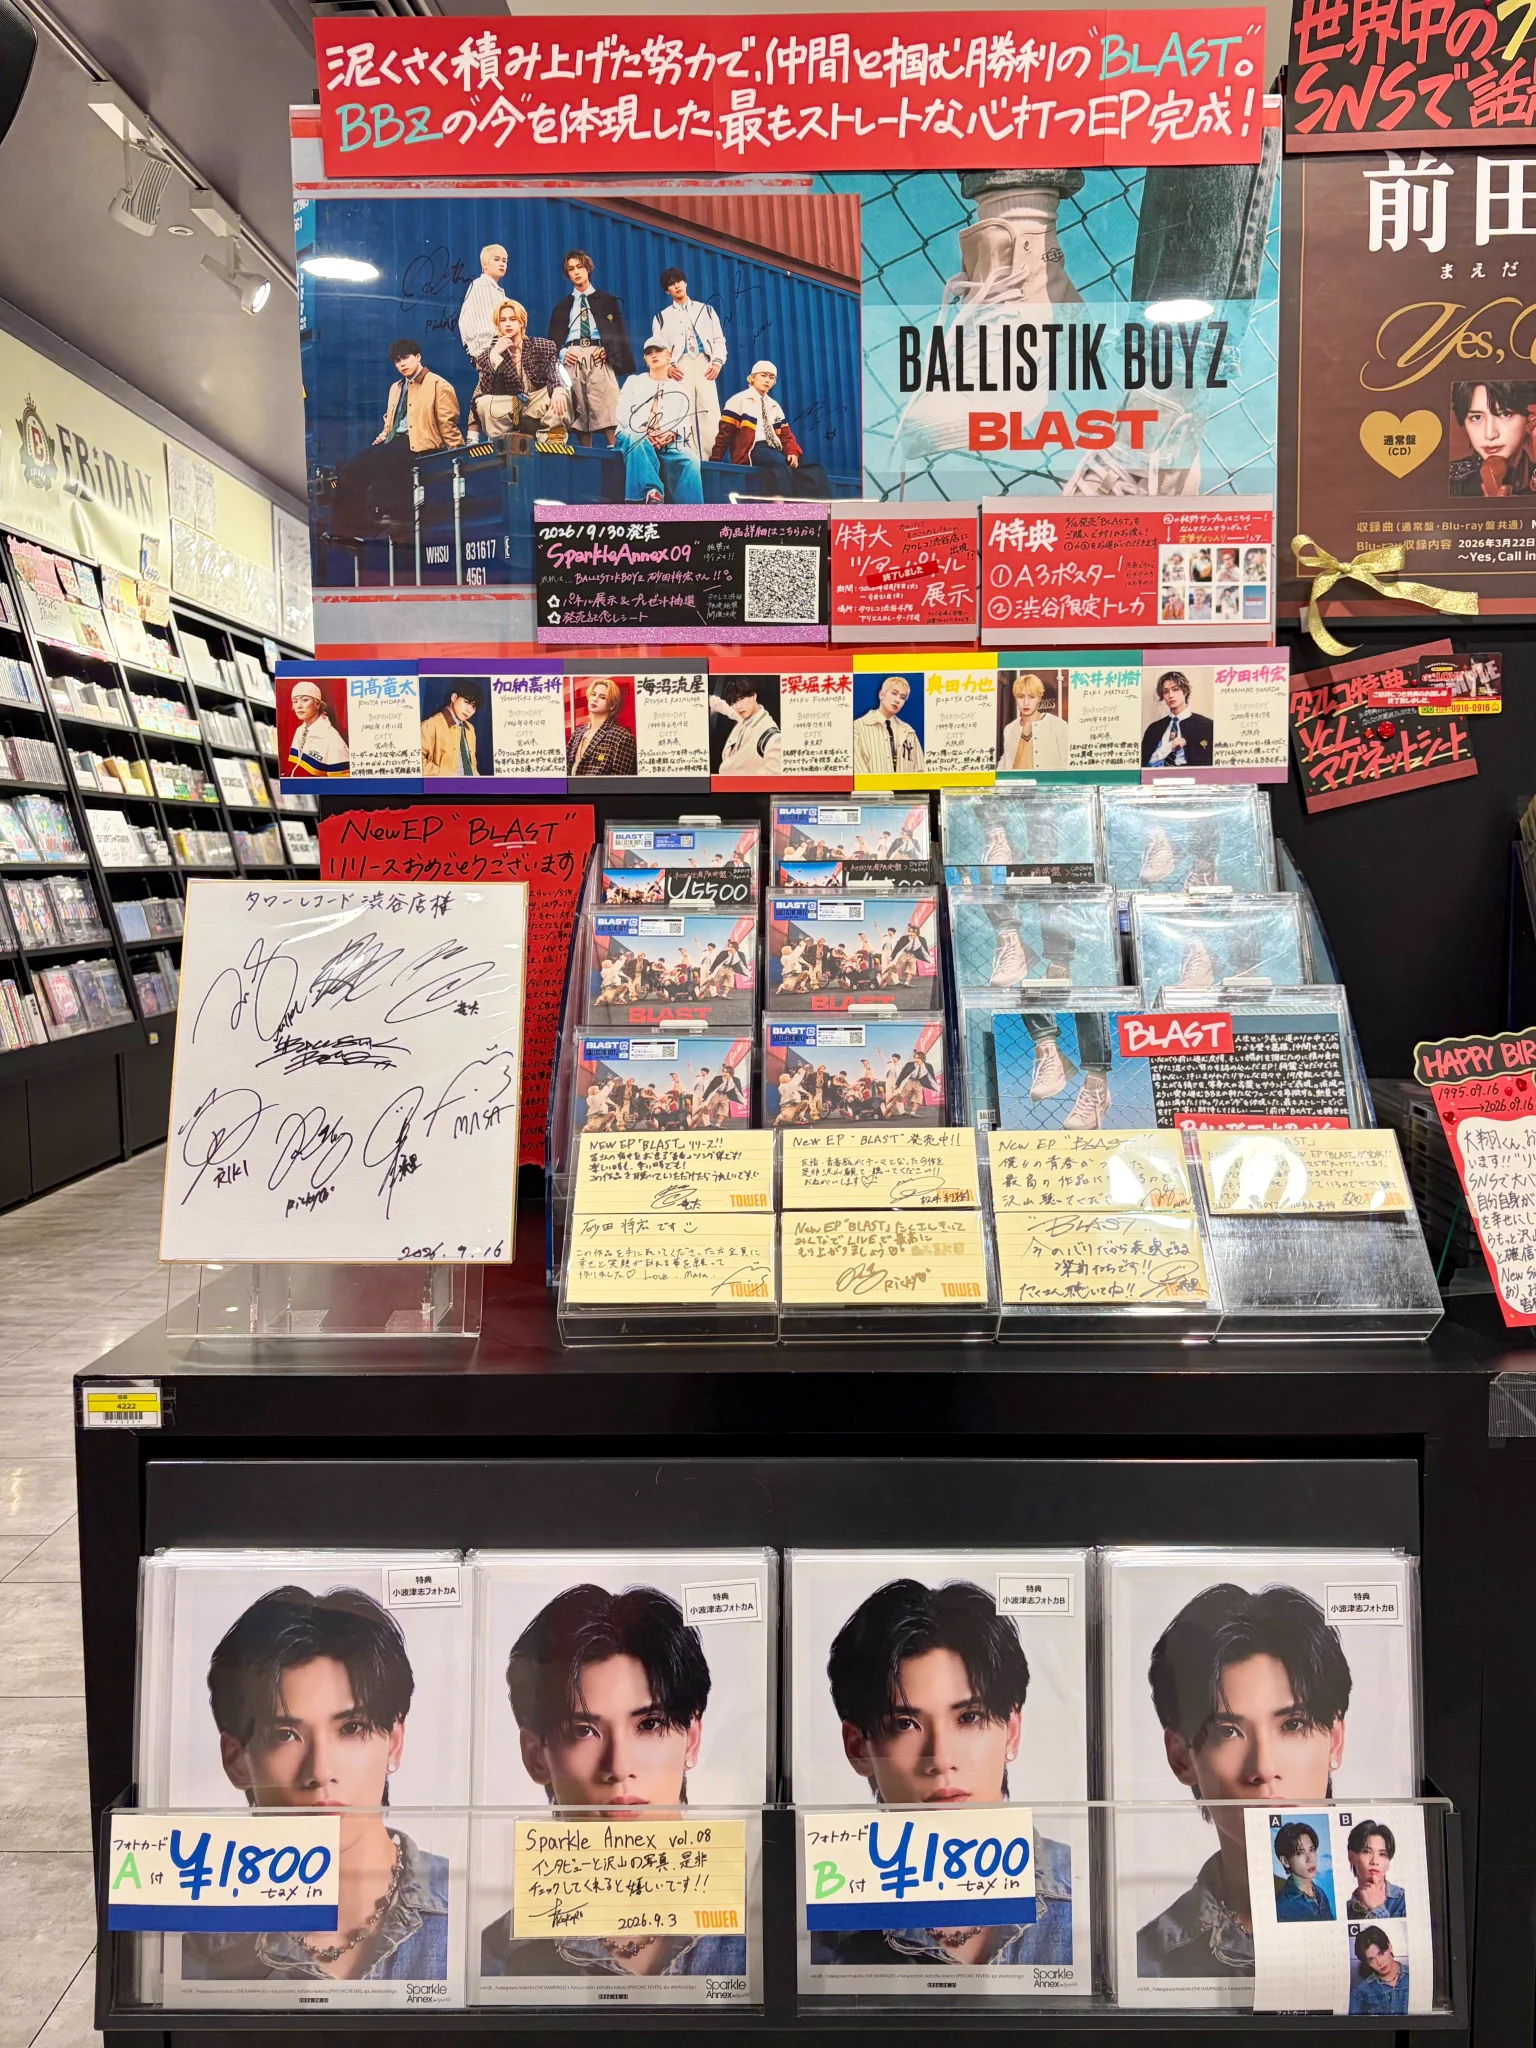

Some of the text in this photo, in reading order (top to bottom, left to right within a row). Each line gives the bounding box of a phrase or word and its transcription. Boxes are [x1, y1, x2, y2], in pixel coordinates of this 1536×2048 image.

[1294, 57, 1536, 134] SNSで話
[1362, 150, 1536, 252] 前田
[1440, 261, 1518, 279] まえだ
[1359, 297, 1522, 391] Yes,
[899, 321, 1229, 393] BALLISTIK BOYZ
[968, 409, 1159, 452] BLAST
[1383, 435, 1416, 446] 通常盤
[1388, 446, 1411, 456] (CD)
[539, 522, 661, 541] 2026/9/30発売
[719, 524, 821, 538] 商品詳細はこちらから！
[835, 521, 892, 551] 特大
[988, 517, 1058, 553] 特典
[1458, 538, 1535, 548] 2026年3月22日
[426, 539, 496, 564] WHSU 831617
[1498, 551, 1522, 561] Call
[882, 567, 924, 582] 終了しました
[921, 581, 974, 608] 展示
[926, 673, 995, 696] 奥田力也
[1070, 670, 1141, 690] 松井利樹
[1214, 666, 1287, 687] 砂田将宏
[492, 676, 563, 695] 加納嘉将
[637, 675, 706, 695] 海沼流星
[781, 675, 852, 695] 深堀未来
[1298, 716, 1361, 762] YCL
[1309, 722, 1468, 790] マグネットシート
[330, 850, 589, 882] リリースおめでとうございます！
[628, 1007, 712, 1024] BLAST
[1124, 1019, 1227, 1051] BLAST
[1423, 1046, 1494, 1079] HAPPY
[1438, 1082, 1499, 1101] 1995.09.16
[1484, 1097, 1534, 1114] 2026.09.16
[589, 1140, 617, 1150] NEW
[619, 1139, 636, 1149] EP
[793, 1134, 820, 1147] New
[826, 1134, 845, 1146] EP
[1036, 1139, 1056, 1150] EP
[729, 1194, 768, 1208] TOWER
[795, 1221, 841, 1235] New EP
[1496, 1245, 1536, 1265] と確信
[1501, 1267, 1523, 1283] New
[729, 1282, 769, 1298] TOWER
[941, 1283, 981, 1297] TOWER
[415, 1575, 432, 1585] 特典
[392, 1585, 457, 1598] 小波津志フォトカA
[712, 1591, 730, 1602] 特典
[1025, 1584, 1043, 1594] 特典
[1353, 1592, 1371, 1602] 特典
[1002, 1594, 1066, 1606] 小波津志フォトカB
[1330, 1602, 1395, 1614] 小波津志フォトカB
[689, 1602, 754, 1616] 小波津志フォトカA
[1271, 1816, 1280, 1826] A
[1341, 1815, 1350, 1825] B
[113, 1836, 168, 1851] フォトカード
[525, 1828, 591, 1851] Sparkle
[604, 1826, 657, 1849] Annex
[807, 1825, 869, 1846] フォトカード
[112, 1852, 164, 1889] A 付
[813, 1861, 866, 1899] B 付
[957, 1877, 1020, 1896] tax in
[261, 1886, 323, 1901] tax in
[618, 1913, 677, 1930] 2026.9.3
[694, 1910, 739, 1928] TOWER
[1350, 1926, 1359, 1936] C
[1033, 1968, 1073, 1980] Sparkle
[406, 1983, 447, 1996] Sparkle
[706, 1979, 746, 1991] Sparkle
[1033, 1980, 1059, 1988] Annex
[406, 1995, 433, 2004] Annex
[706, 1991, 732, 1999] Annex
